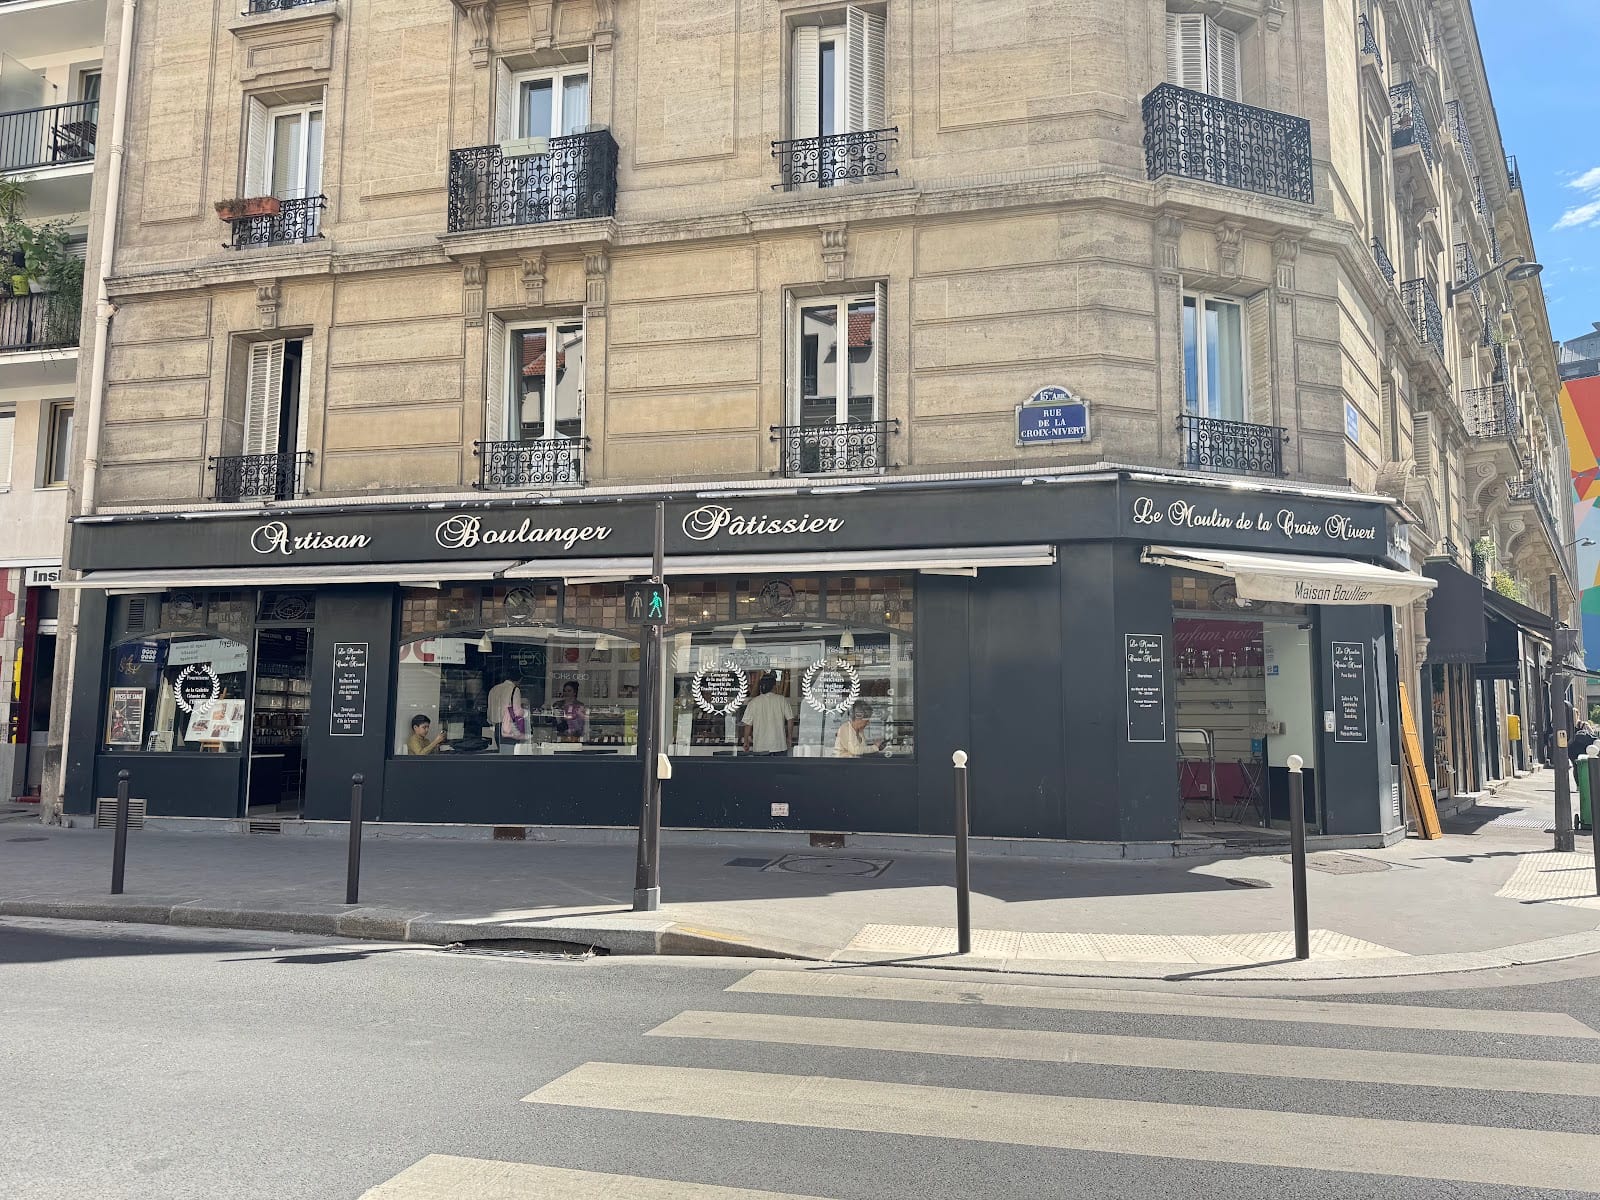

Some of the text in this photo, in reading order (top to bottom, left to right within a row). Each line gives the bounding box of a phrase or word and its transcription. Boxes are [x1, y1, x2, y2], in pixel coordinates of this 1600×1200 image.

[1038, 418, 1067, 428] DE LA
[1043, 408, 1062, 417] RUE
[1021, 426, 1086, 438] CROIX-NIVERT
[435, 514, 612, 550] Boulanger
[682, 504, 845, 541] Pâtissier
[1133, 497, 1164, 525] Le
[1167, 500, 1234, 529] Moulin
[1235, 511, 1254, 531] de
[1257, 512, 1273, 531] la
[1276, 509, 1322, 540] Croix
[1325, 514, 1376, 541] Nivert
[250, 521, 372, 556] Artisan
[1294, 581, 1331, 600] Maison
